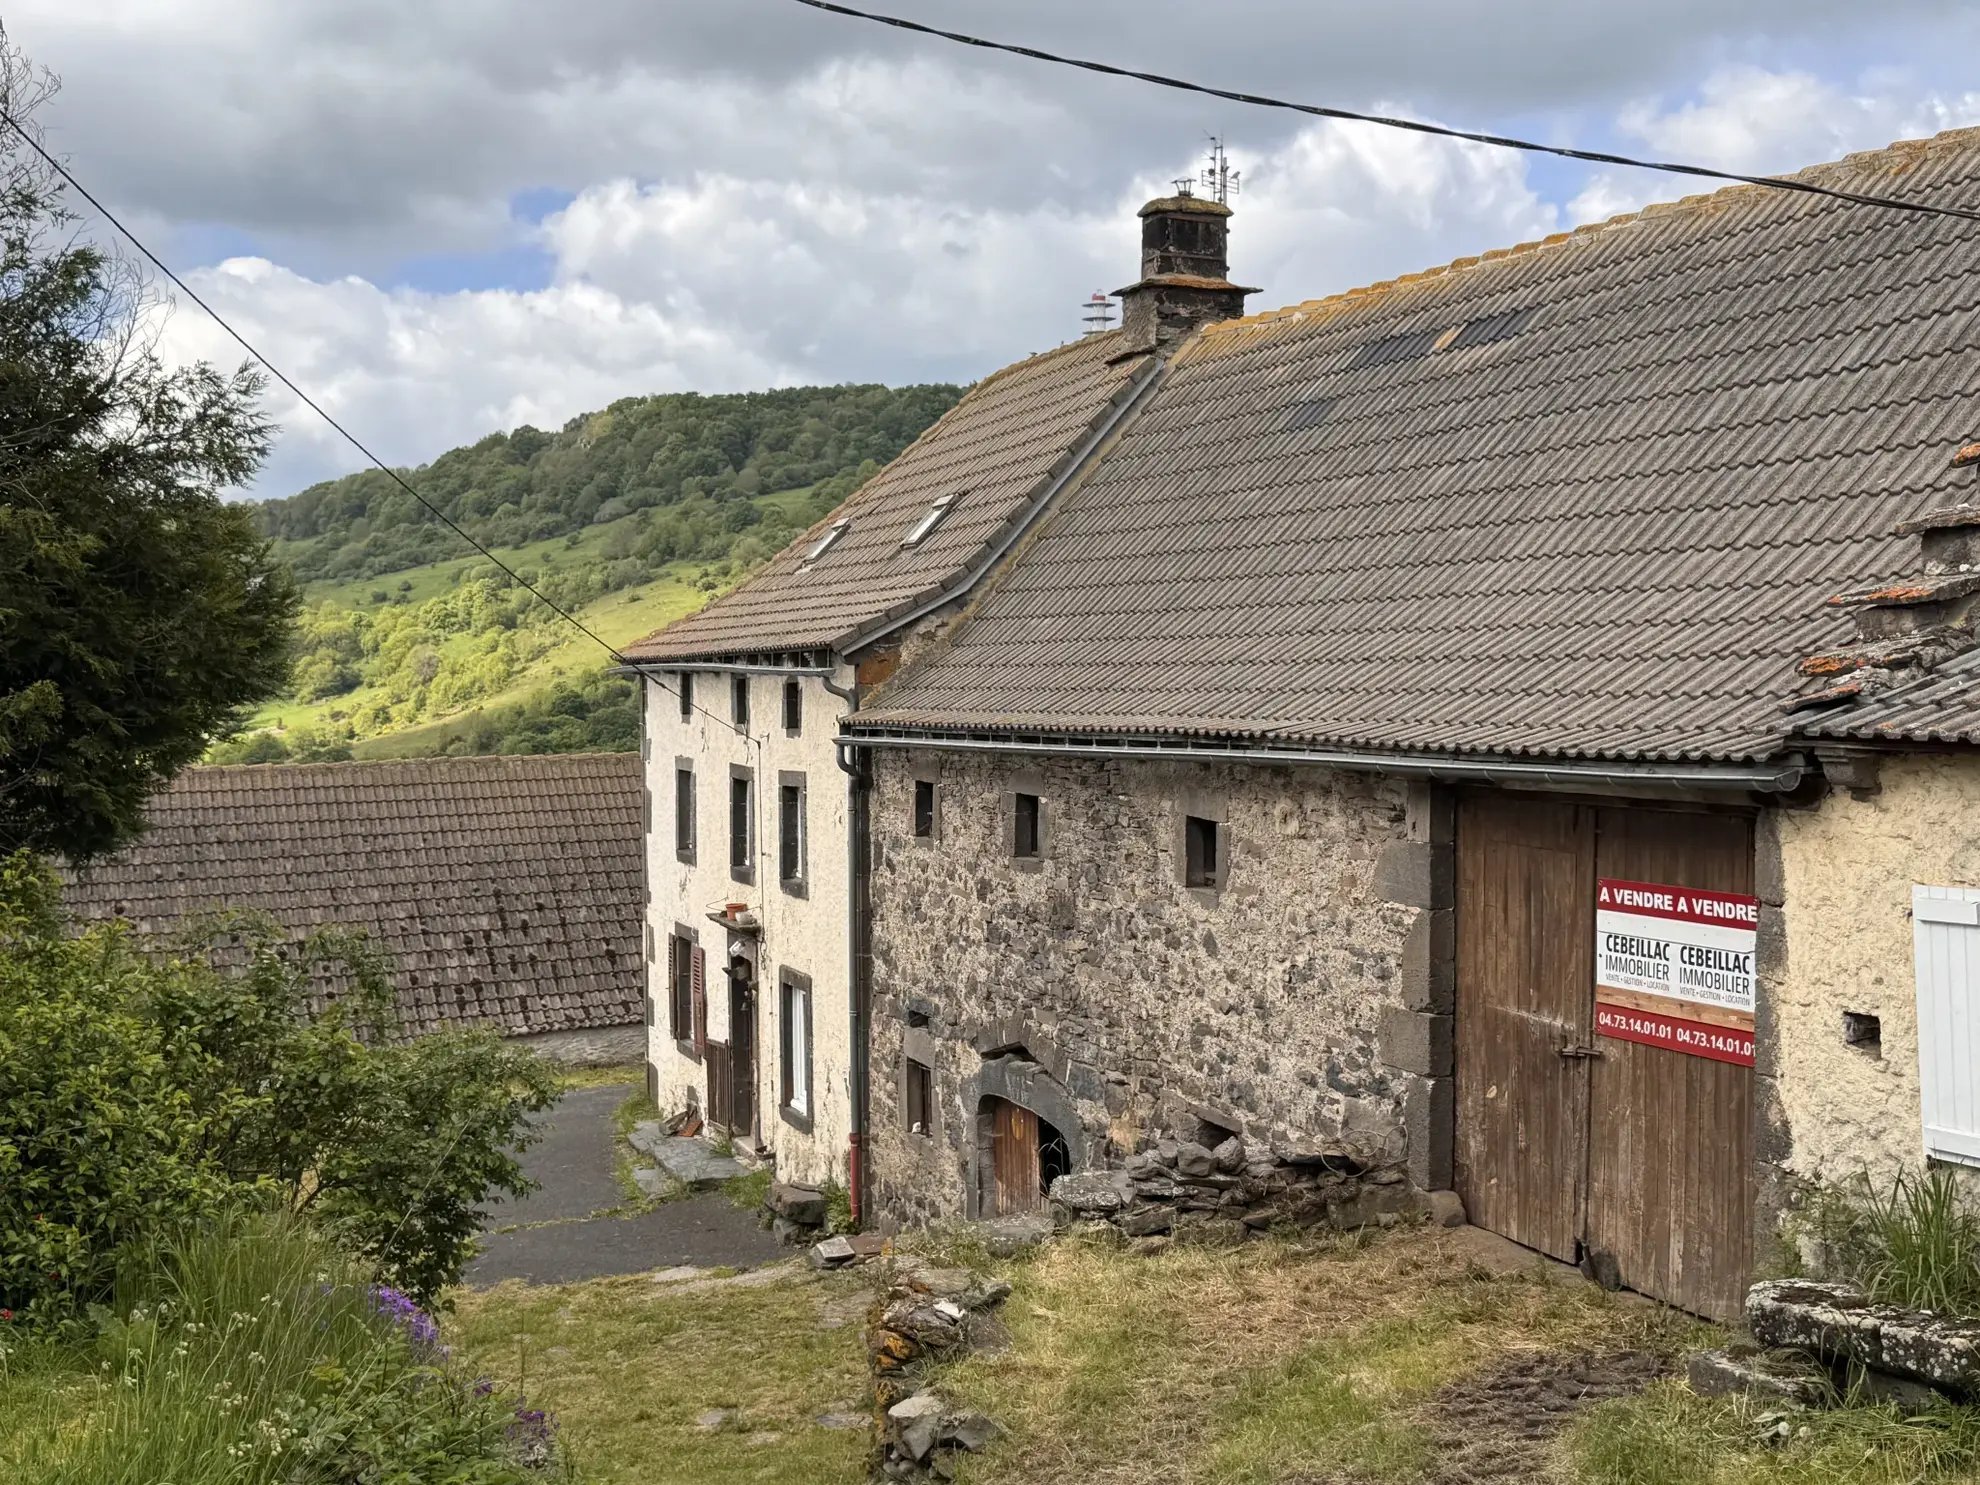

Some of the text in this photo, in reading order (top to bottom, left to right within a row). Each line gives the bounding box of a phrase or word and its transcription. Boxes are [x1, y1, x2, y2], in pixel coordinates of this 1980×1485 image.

[1600, 887, 1757, 922] A VENDRE A VENDRE
[1606, 934, 1670, 961] CEBEILLAC
[1680, 946, 1750, 974] CEBEILLAC
[1606, 955, 1669, 981] IMMOBILIER
[1680, 967, 1749, 995] IMMOBILIER
[1606, 974, 1670, 992] VENTE GESTION LOCATION
[1680, 987, 1750, 1006] VENTE GESTION LOCATION
[1599, 1012, 1671, 1039] 04.73.14.01.01
